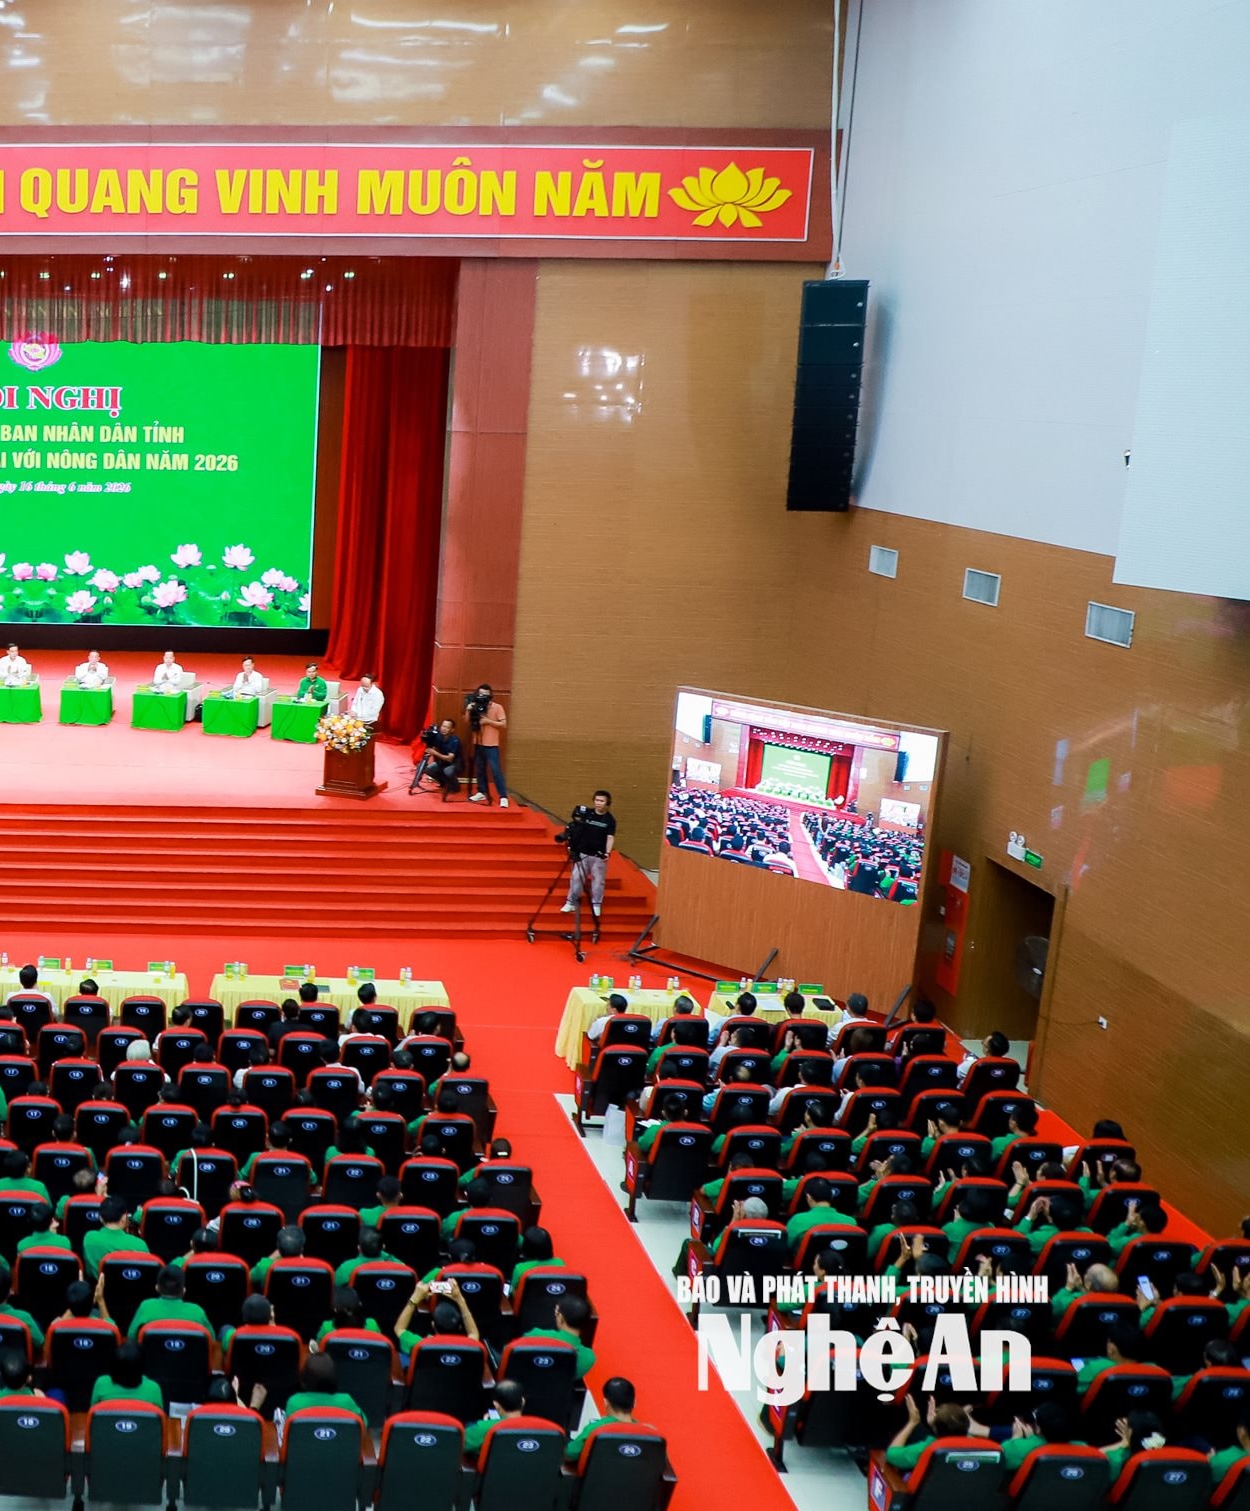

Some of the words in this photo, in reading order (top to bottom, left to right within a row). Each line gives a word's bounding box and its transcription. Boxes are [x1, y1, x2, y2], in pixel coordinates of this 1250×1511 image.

[20, 167, 199, 218] QUANG
[215, 168, 339, 214] VINH
[357, 156, 517, 216] MUÔN
[534, 158, 660, 217] NĂM
[26, 385, 123, 418] NGHỊ
[0, 425, 38, 442] BAN
[43, 422, 94, 443] NHÂN
[100, 423, 137, 443] DÂN
[143, 421, 185, 443] TỈNH
[12, 448, 41, 468] VỚI
[46, 449, 97, 470] NÔNG
[103, 450, 141, 470] DÂN
[146, 450, 189, 471] NĂM
[194, 454, 238, 472] 2026
[296, 1277, 306, 1285] 21
[381, 1280, 391, 1288] 22
[466, 1283, 477, 1291] 23
[319, 1429, 331, 1438] 21
[419, 1435, 432, 1444] 22
[624, 1446, 636, 1454] 24
